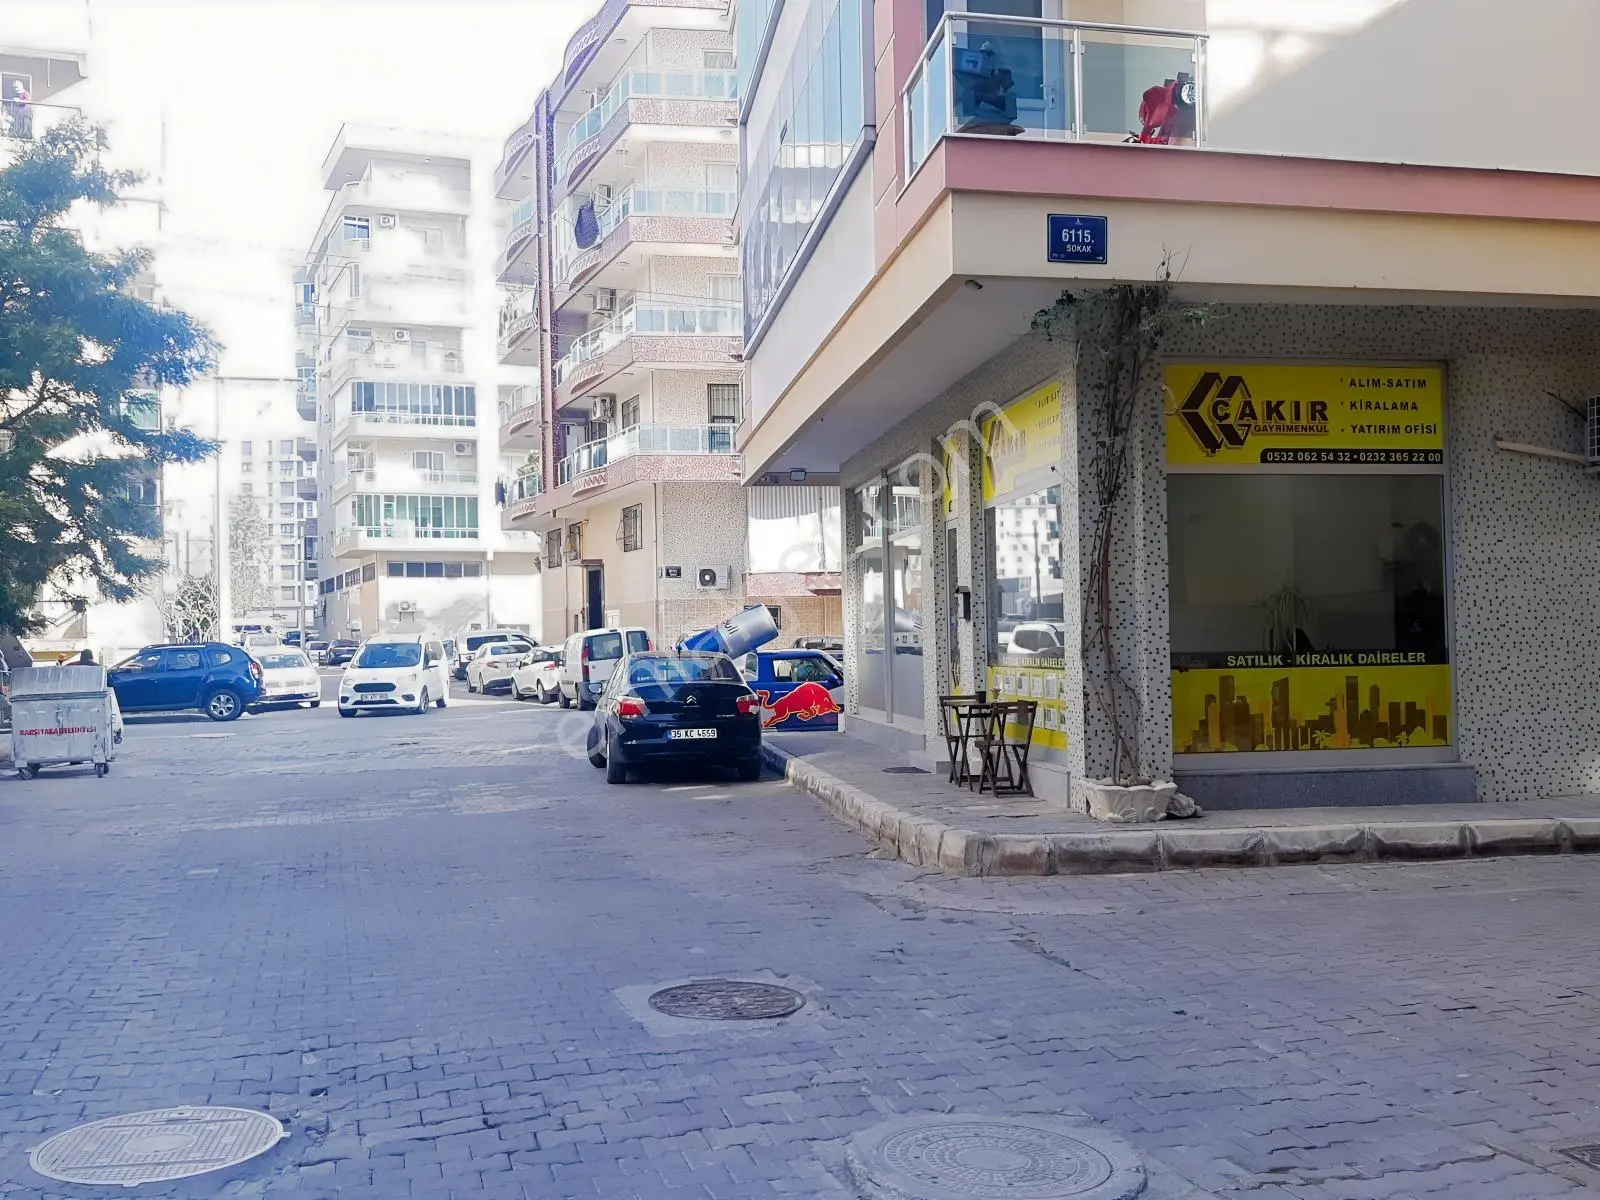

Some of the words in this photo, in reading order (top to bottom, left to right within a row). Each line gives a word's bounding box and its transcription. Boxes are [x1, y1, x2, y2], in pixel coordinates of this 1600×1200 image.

[1061, 228, 1095, 243] 6115.
[1066, 244, 1092, 253] SOKAK
[1349, 378, 1427, 388] ALIM-SATIM
[1349, 399, 1418, 411] KİRALAMA
[1211, 400, 1329, 423] ÇAKIR
[1253, 423, 1330, 433] GAYRİMENKUL
[1350, 424, 1400, 434] YATIRIM
[1404, 422, 1437, 434] OFİSİ
[1266, 452, 1294, 461] 0532
[1297, 452, 1318, 461] 062
[1321, 452, 1334, 461] 54
[1389, 452, 1409, 461] 365
[1412, 452, 1425, 461] 22
[1428, 452, 1441, 461] 00
[1227, 655, 1284, 667] SATILIK
[1295, 652, 1355, 665] KİRALIK
[1358, 651, 1426, 664] DAİRELER
[684, 729, 695, 738] KC
